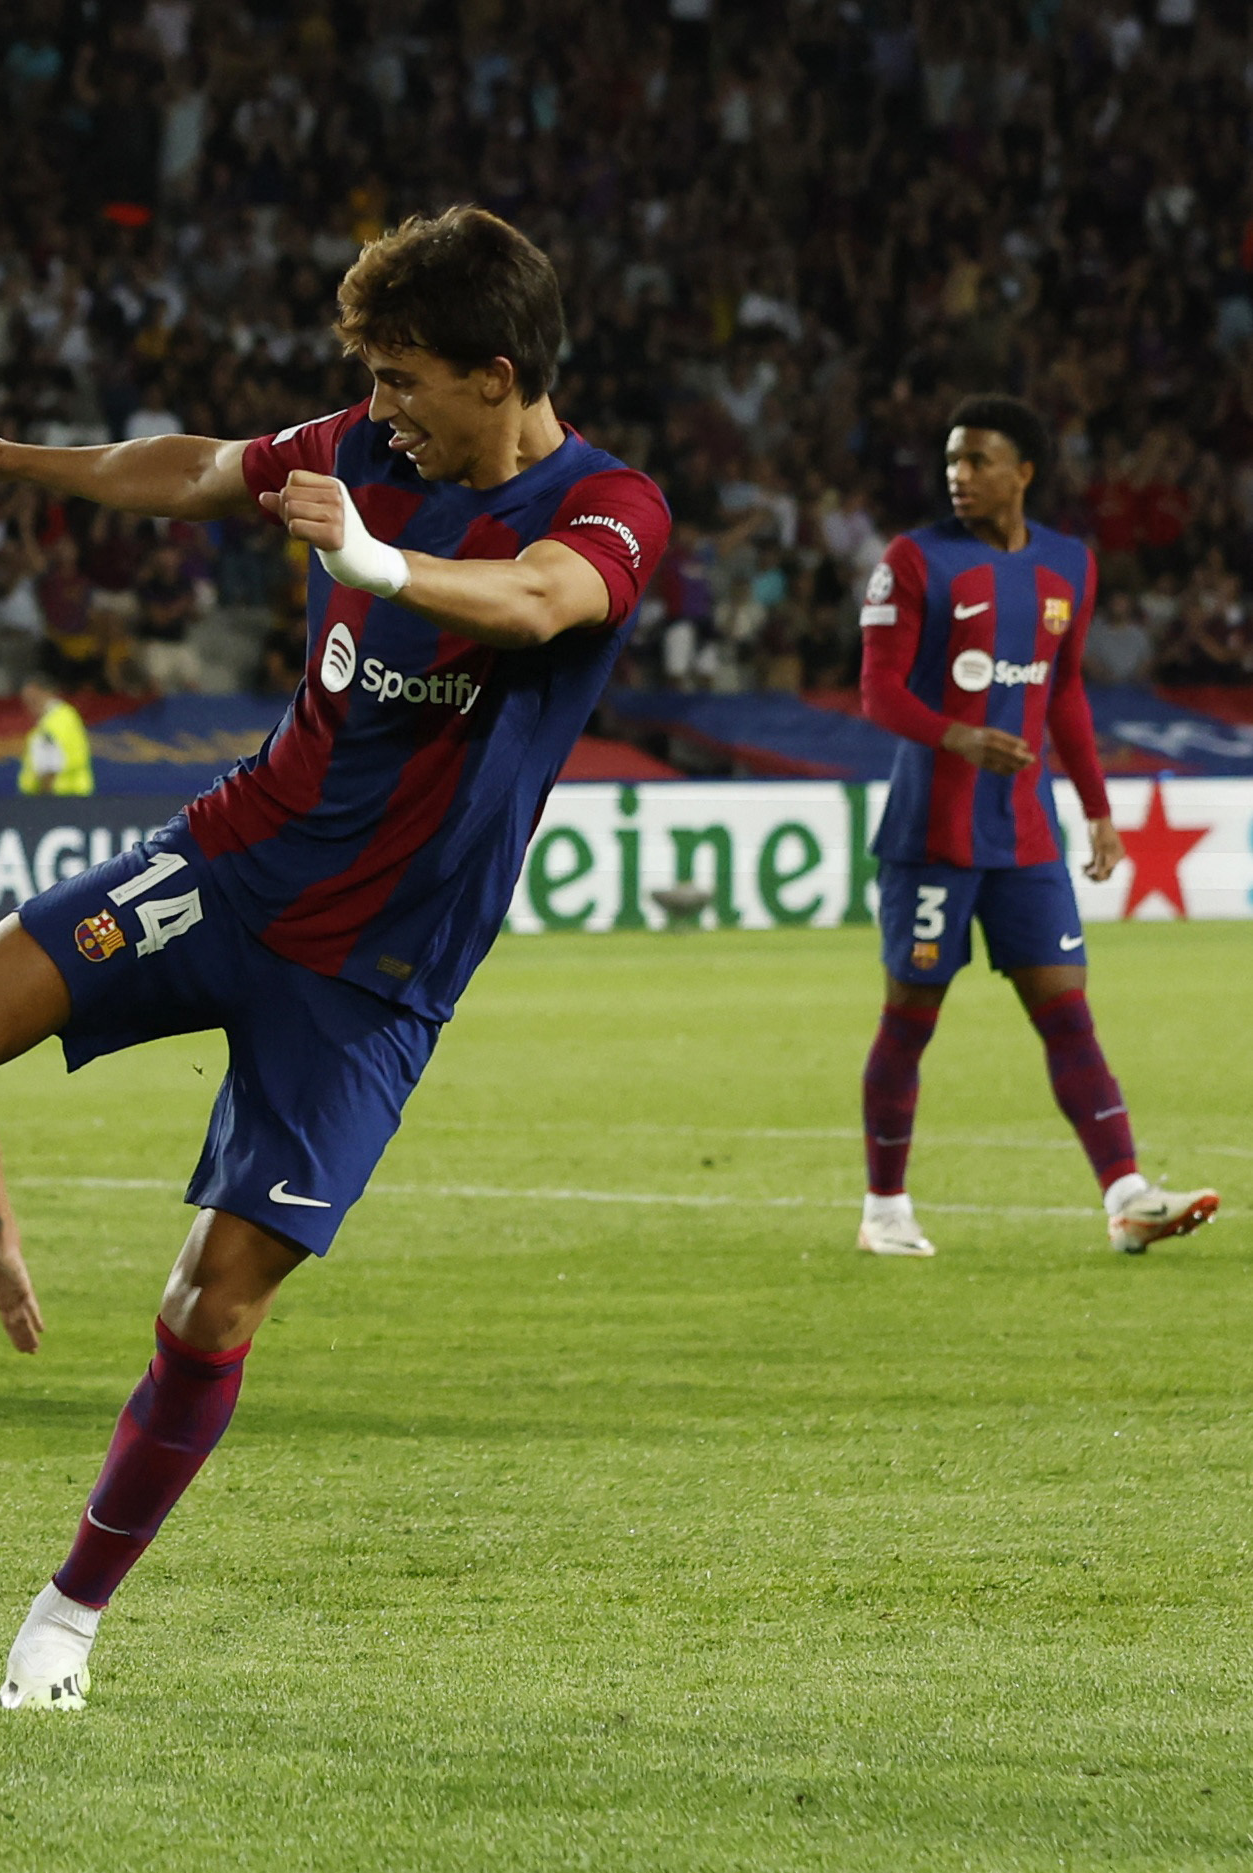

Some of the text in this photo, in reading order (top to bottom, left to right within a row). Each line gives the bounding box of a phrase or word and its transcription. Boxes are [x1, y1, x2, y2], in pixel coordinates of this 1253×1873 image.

[570, 514, 640, 555] AMBILIGHT
[360, 657, 481, 715] Spotify
[994, 659, 1050, 688] Spotif
[504, 784, 880, 931] einek
[107, 851, 204, 958] 14
[912, 885, 948, 941] 3
